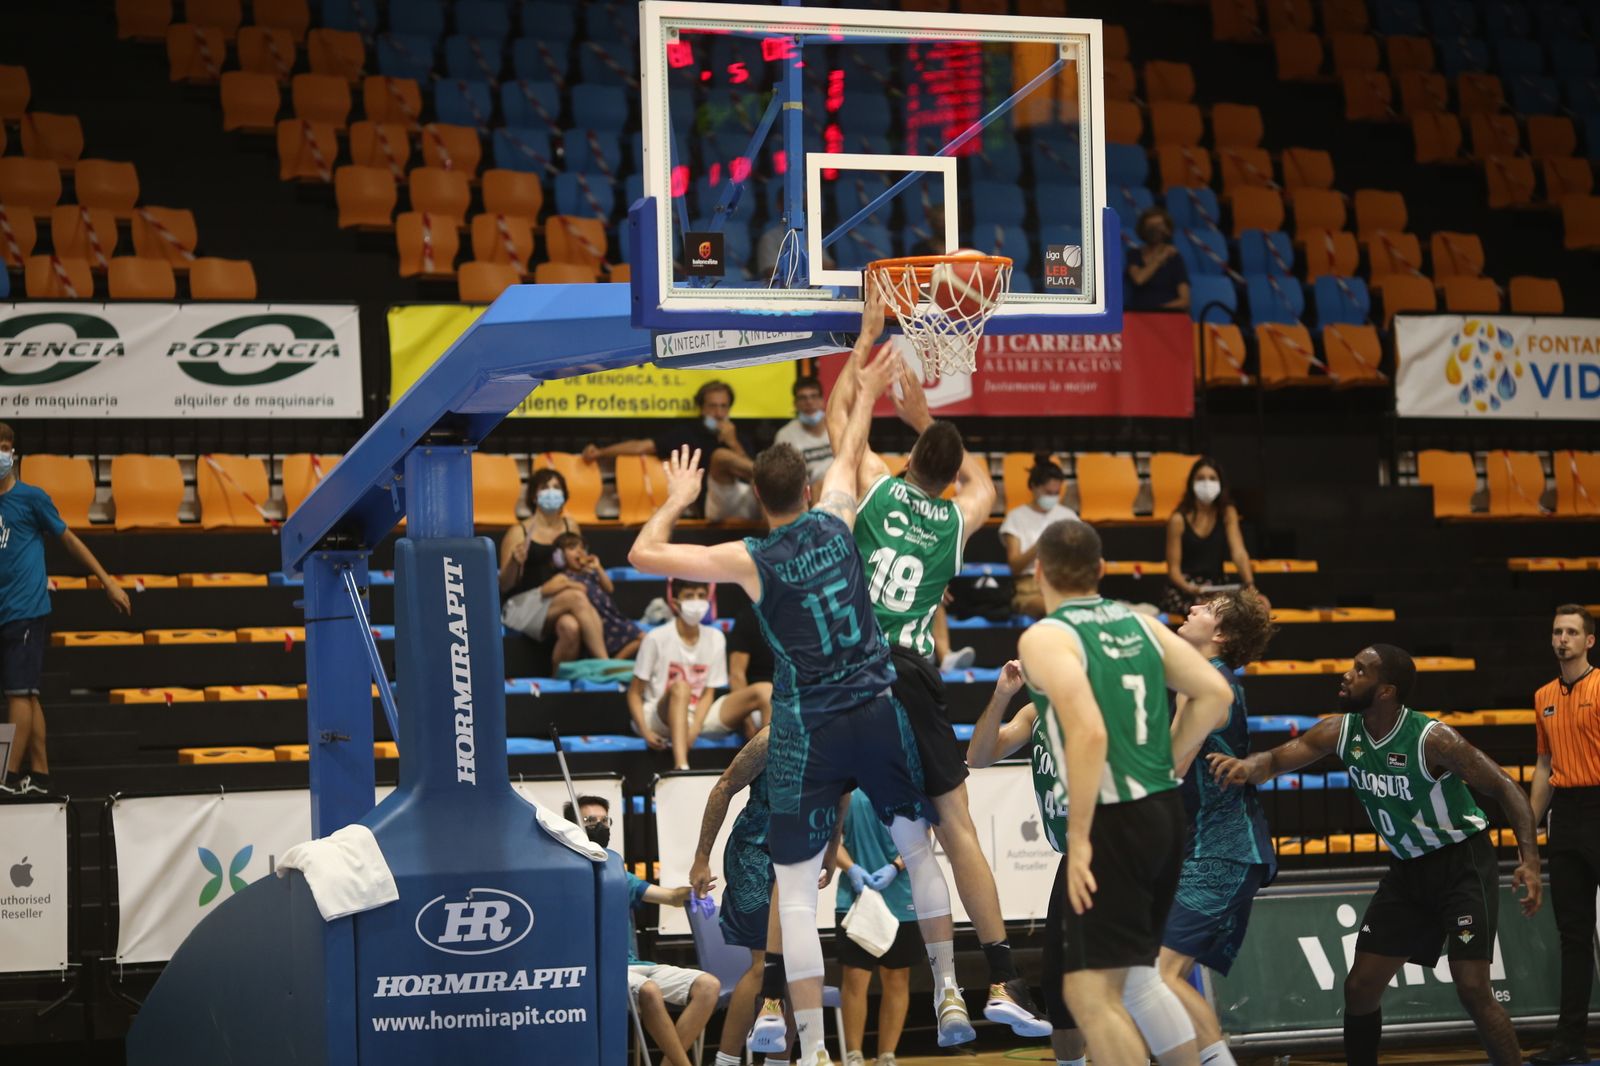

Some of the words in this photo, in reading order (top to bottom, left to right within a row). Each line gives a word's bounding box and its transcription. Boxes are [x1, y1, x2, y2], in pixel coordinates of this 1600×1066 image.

[1046, 265, 1068, 276] LEB
[1046, 276, 1076, 286] PLATA
[166, 342, 340, 358] POTENCIA
[674, 333, 710, 351] INTECAT
[1009, 334, 1122, 352] CARRERAS
[12, 394, 29, 406] de
[35, 394, 118, 409] maquinaria
[174, 394, 226, 409] alquiler
[233, 394, 250, 406] de
[254, 394, 335, 409] maquinaria
[575, 393, 700, 412] Professiona
[868, 546, 923, 612] 18
[801, 578, 861, 656] 15
[443, 556, 476, 786] HORMIRAPIT
[1, 907, 43, 919] Reseller
[438, 900, 512, 944] HR
[373, 966, 587, 998] HORMIRAPIT
[372, 1006, 587, 1031] www.hormirapit.com
